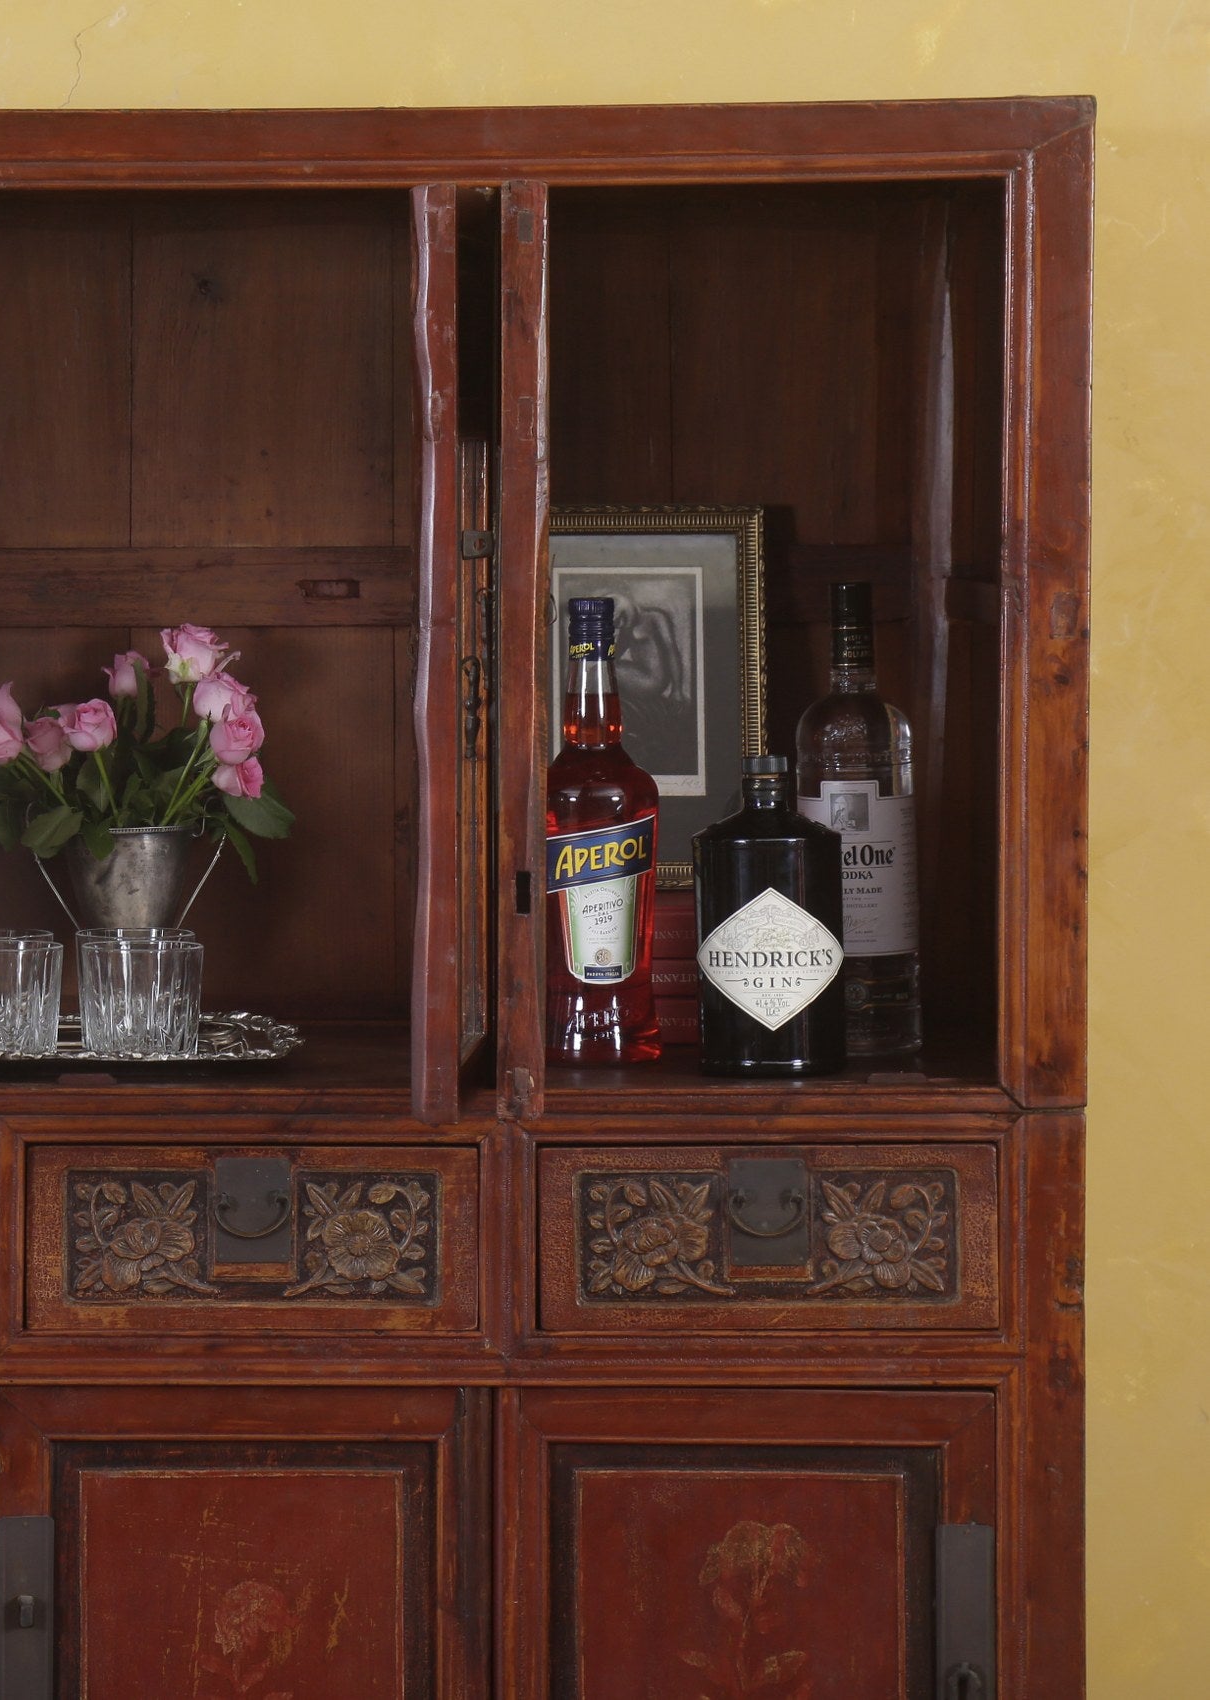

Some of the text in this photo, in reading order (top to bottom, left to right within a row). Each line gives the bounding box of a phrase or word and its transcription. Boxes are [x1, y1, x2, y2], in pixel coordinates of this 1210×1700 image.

[555, 836, 647, 880] APEROL
[860, 844, 894, 866] One
[842, 871, 873, 880] ODKA
[582, 898, 624, 915] APERITIVO
[594, 914, 613, 926] 1919
[709, 948, 833, 968] HENDRICK'S
[752, 977, 793, 989] GIN
